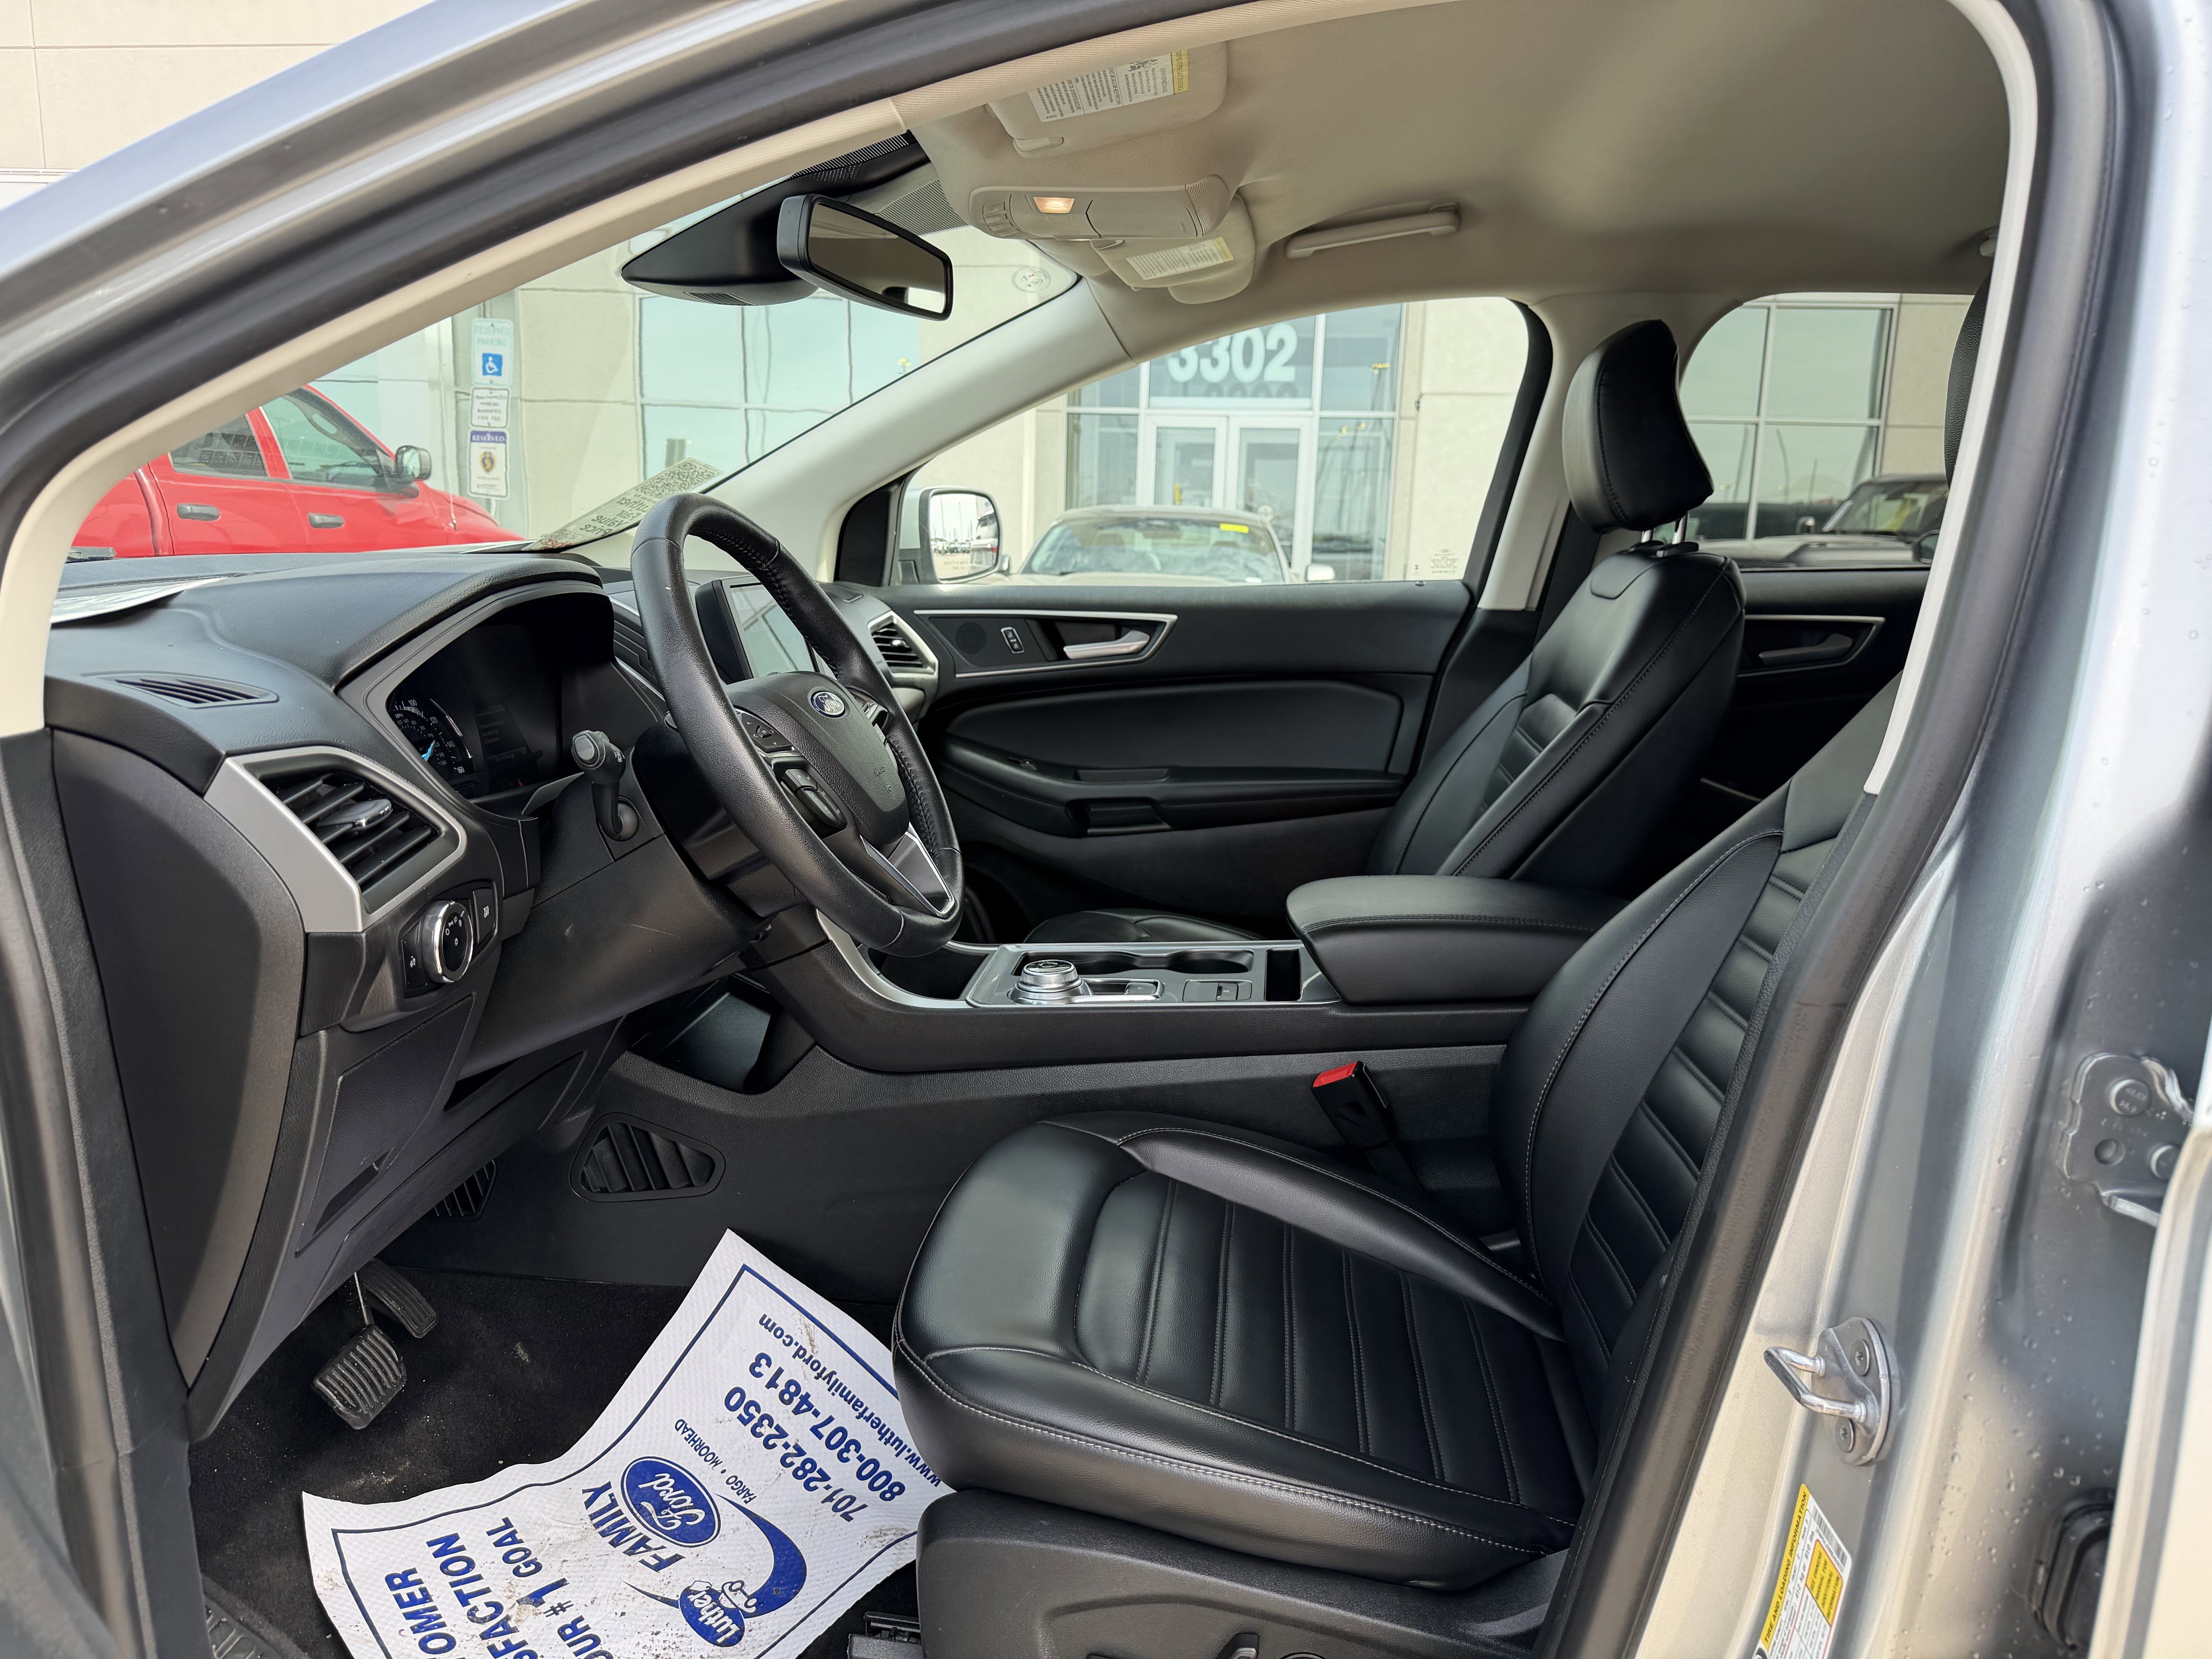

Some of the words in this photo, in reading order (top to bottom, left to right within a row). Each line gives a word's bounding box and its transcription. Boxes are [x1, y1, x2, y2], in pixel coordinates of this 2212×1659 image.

[477, 338, 507, 347] PARKING
[1167, 323, 1298, 383] 3302
[749, 1352, 906, 1501] 800-307-4813
[758, 1313, 941, 1487] www.lutherfamilyford.com
[674, 1419, 723, 1468] MOORHEAD
[725, 1386, 869, 1522] 701-282-2350
[638, 1473, 706, 1530] Ford
[726, 1475, 757, 1504] FARGO
[486, 1517, 543, 1578] GOAL
[582, 1480, 686, 1573] FAMILY
[1764, 1620, 1774, 1643] TIRE
[1772, 1601, 1780, 1622] AND
[1778, 1558, 1791, 1600] LOADING
[1789, 1491, 1807, 1558] INFORMATION
[385, 1567, 465, 1659] OMER
[687, 1589, 740, 1644] Luther
